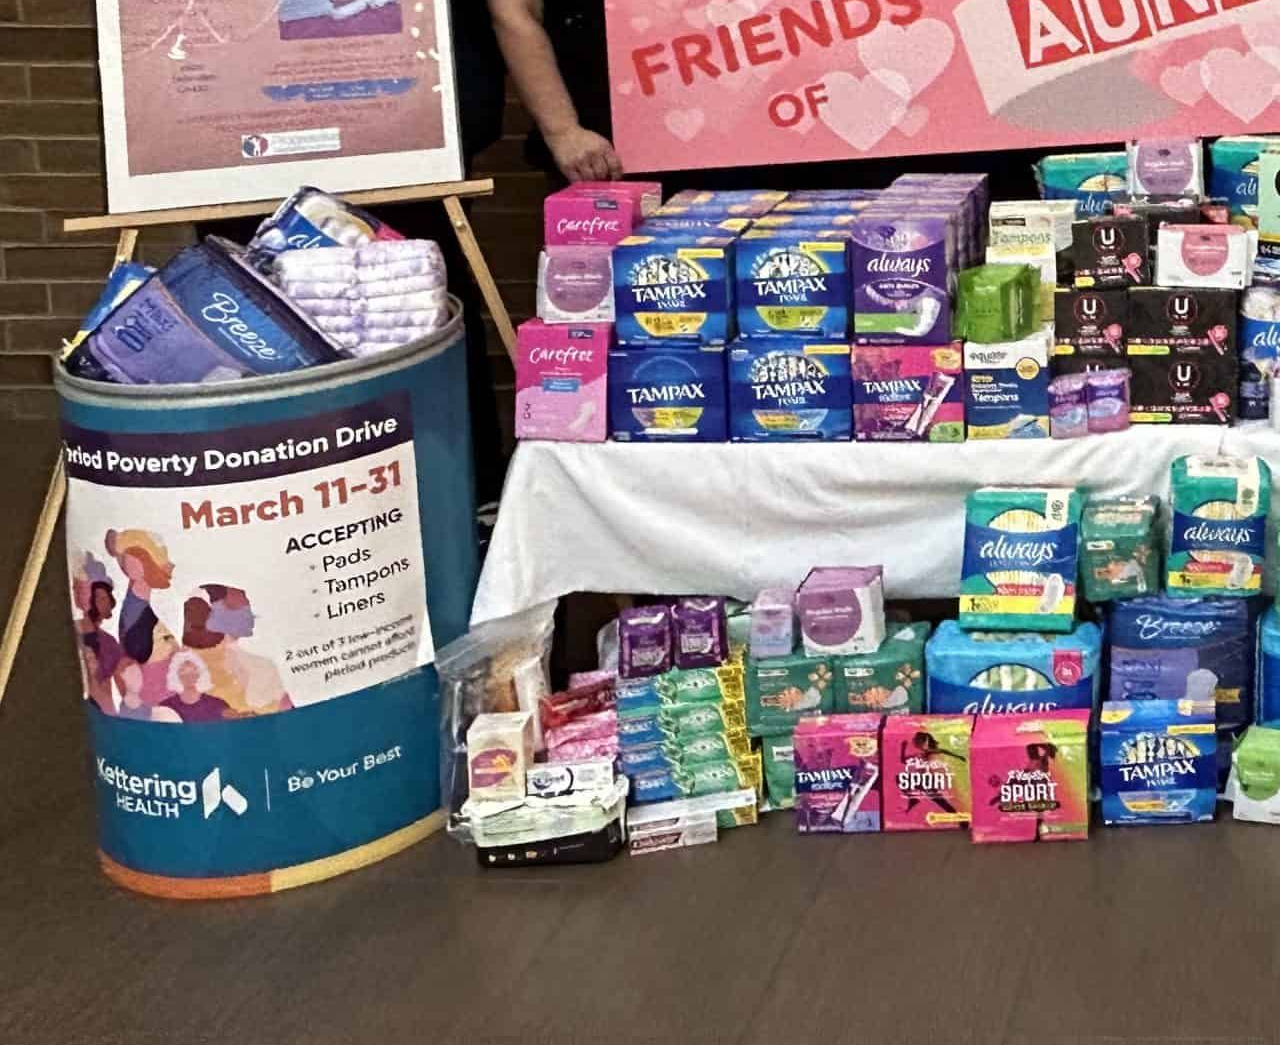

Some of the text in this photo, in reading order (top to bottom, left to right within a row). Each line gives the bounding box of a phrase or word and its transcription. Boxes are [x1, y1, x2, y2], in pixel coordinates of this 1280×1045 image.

[767, 83, 829, 128] OF
[556, 216, 620, 235] Carefree
[1100, 228, 1115, 245] U
[867, 252, 931, 278] always
[632, 283, 707, 303] TAMPAX
[753, 277, 827, 296] TAMPAX
[1082, 299, 1097, 315] U
[1174, 298, 1189, 315] U
[201, 292, 281, 360] Breeze
[529, 346, 594, 365] Carefree
[1177, 365, 1191, 382] U
[626, 383, 705, 404] TAMPAX
[751, 380, 826, 401] TAMPAX
[862, 380, 922, 394] TAMPAX
[106, 451, 197, 476] Poverty
[204, 436, 329, 470] Donation
[336, 416, 399, 447] Drive
[181, 459, 403, 531] March 11-31
[285, 507, 404, 554] ACCEPTING
[1183, 522, 1255, 545] always
[322, 547, 372, 573] Pads
[980, 534, 1057, 565] always
[324, 557, 410, 595] Tampons
[326, 592, 386, 620] Liners
[285, 650, 293, 660] 2
[296, 645, 319, 657] out
[322, 639, 335, 652] of
[290, 655, 339, 675] women
[323, 659, 366, 683] period
[288, 745, 403, 792] Be Your Best
[797, 767, 853, 783] TAMPAX
[1119, 757, 1197, 782] TAMPAX
[96, 756, 197, 805] Kettering
[899, 772, 955, 790] SPORT
[1001, 783, 1058, 802] SPORT
[116, 794, 180, 819] HEALTH
